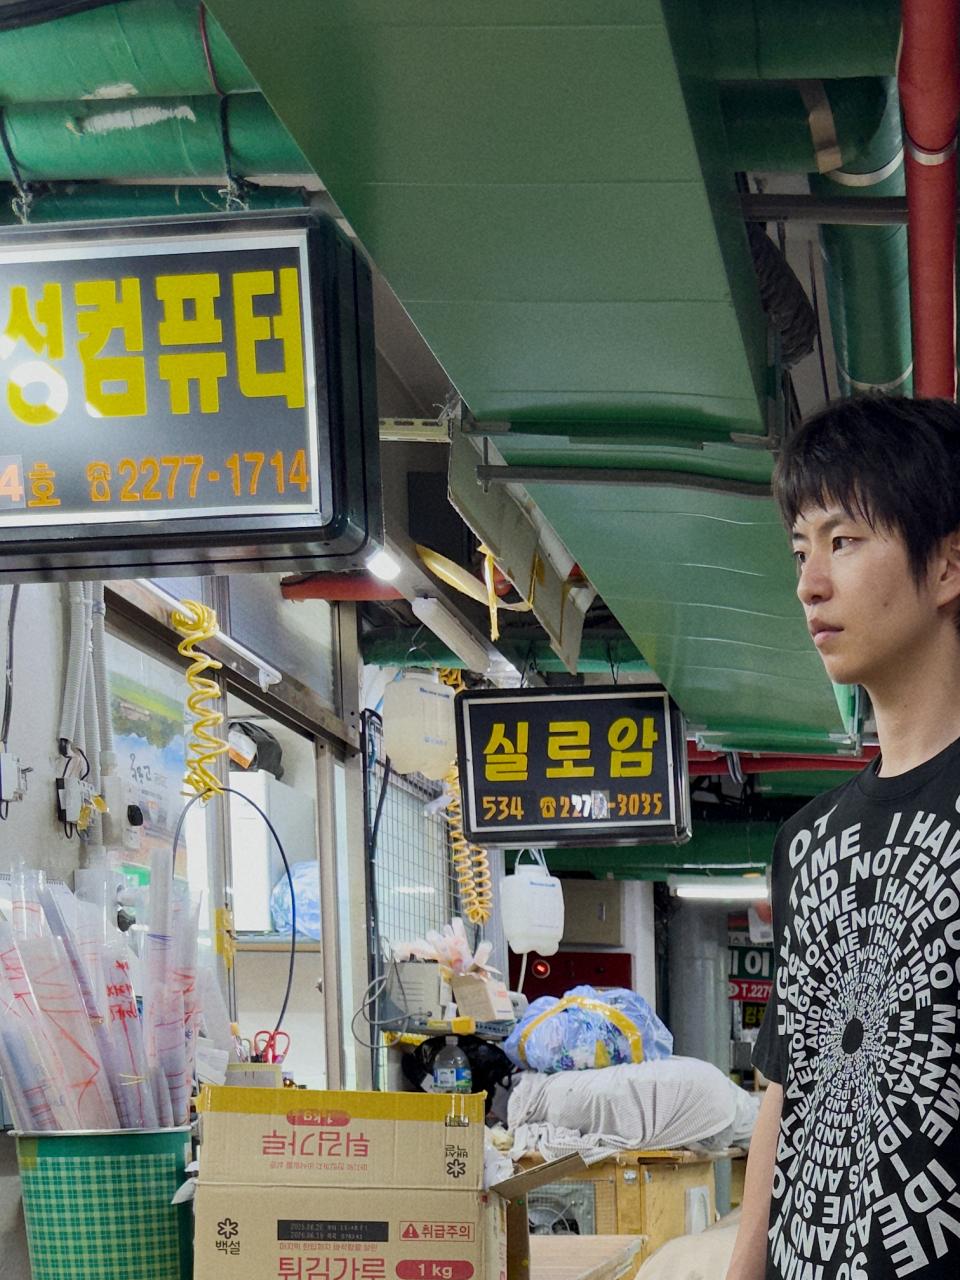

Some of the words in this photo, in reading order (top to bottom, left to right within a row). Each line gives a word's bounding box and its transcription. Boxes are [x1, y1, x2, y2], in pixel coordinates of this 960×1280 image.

[118, 449, 309, 502] 2277-1714
[483, 717, 659, 782] 실로암
[482, 796, 524, 820] 534
[850, 846, 910, 883] NOT
[883, 877, 936, 938] HAVE
[903, 932, 932, 1010] TIME
[923, 937, 955, 990] SO
[911, 1004, 957, 1119] MANY
[262, 1130, 371, 1158] 튀김가루
[215, 1239, 241, 1255] 백설
[421, 1223, 471, 1241] 취급주의
[418, 1264, 426, 1277] 1
[431, 1263, 454, 1279] kg
